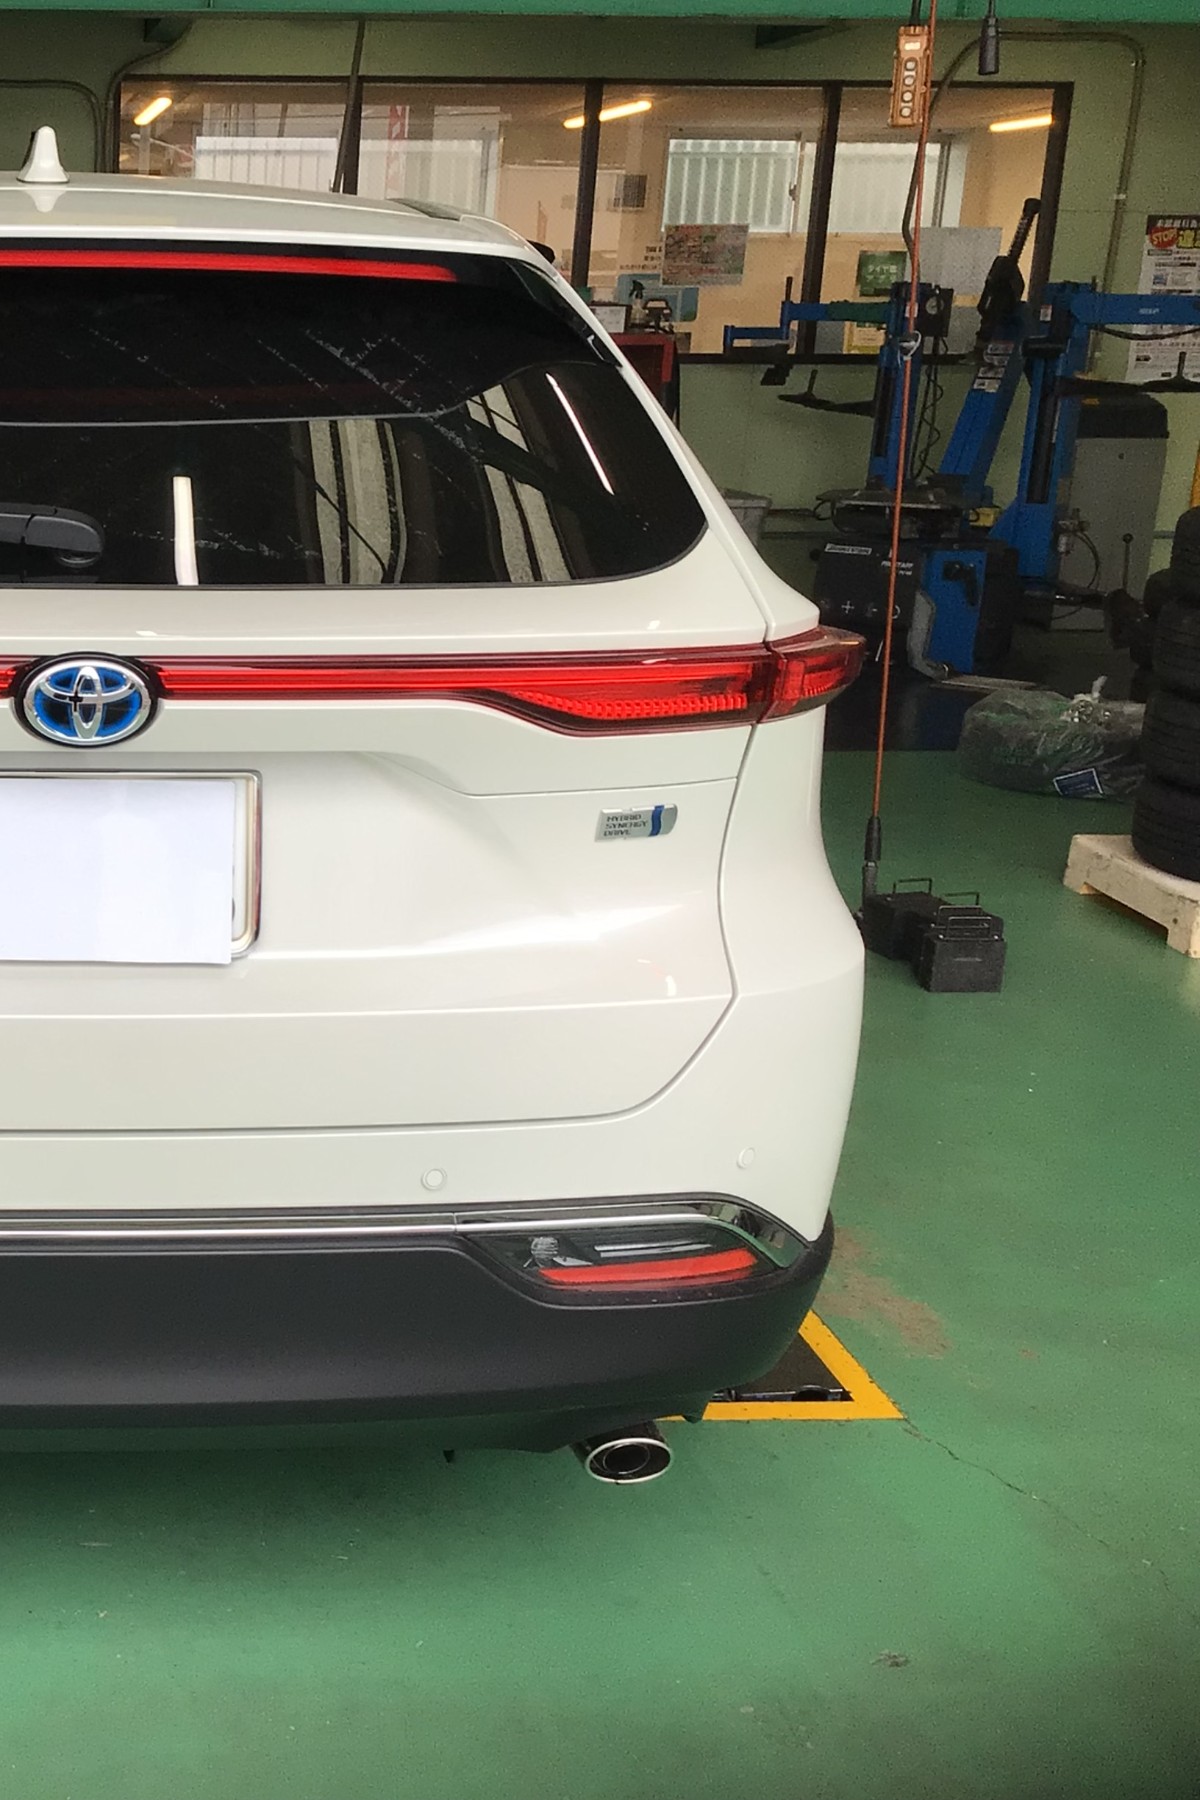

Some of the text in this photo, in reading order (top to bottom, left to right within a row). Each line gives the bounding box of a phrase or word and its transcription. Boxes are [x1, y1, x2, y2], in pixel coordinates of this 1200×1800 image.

[606, 813, 642, 822] HYBRID
[605, 821, 648, 830] SYNERGY
[603, 829, 631, 837] DRIVE
